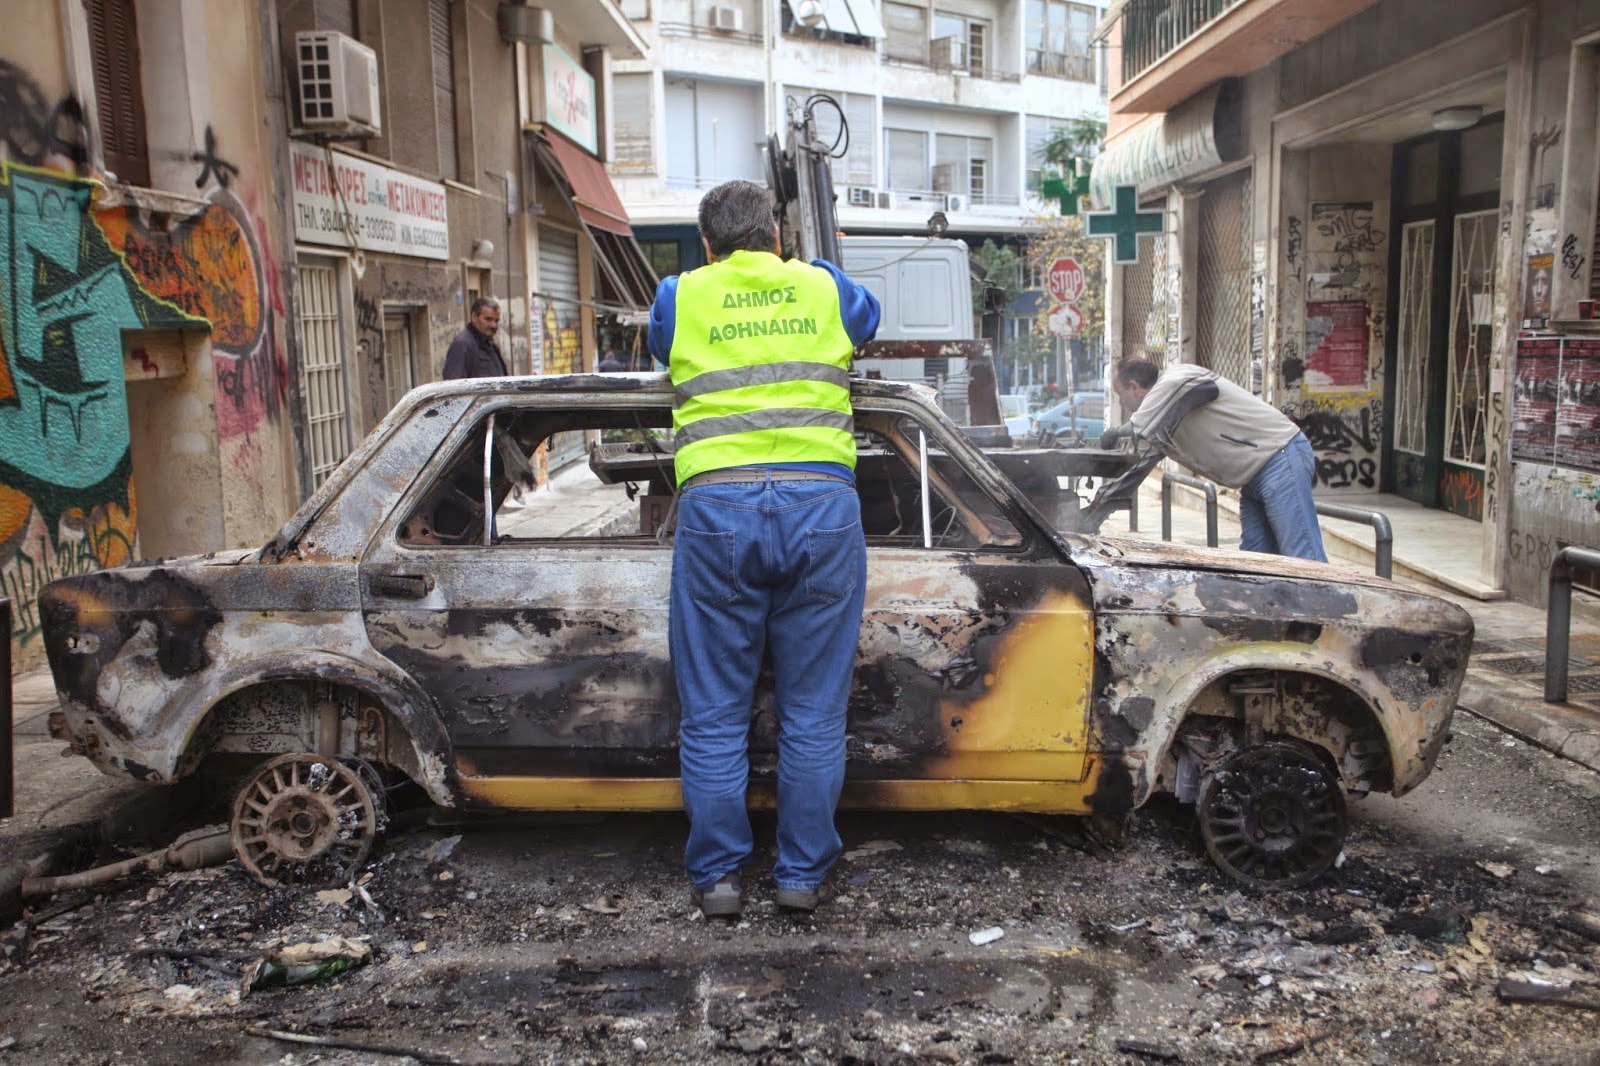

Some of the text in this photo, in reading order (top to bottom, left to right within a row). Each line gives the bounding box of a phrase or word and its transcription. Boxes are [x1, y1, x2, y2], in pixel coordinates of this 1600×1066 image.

[1051, 269, 1082, 294] STOP
[722, 286, 797, 309] ΔΗΜΟΣ
[709, 317, 818, 345] ΑΘΗΝΑΙΩΝ
